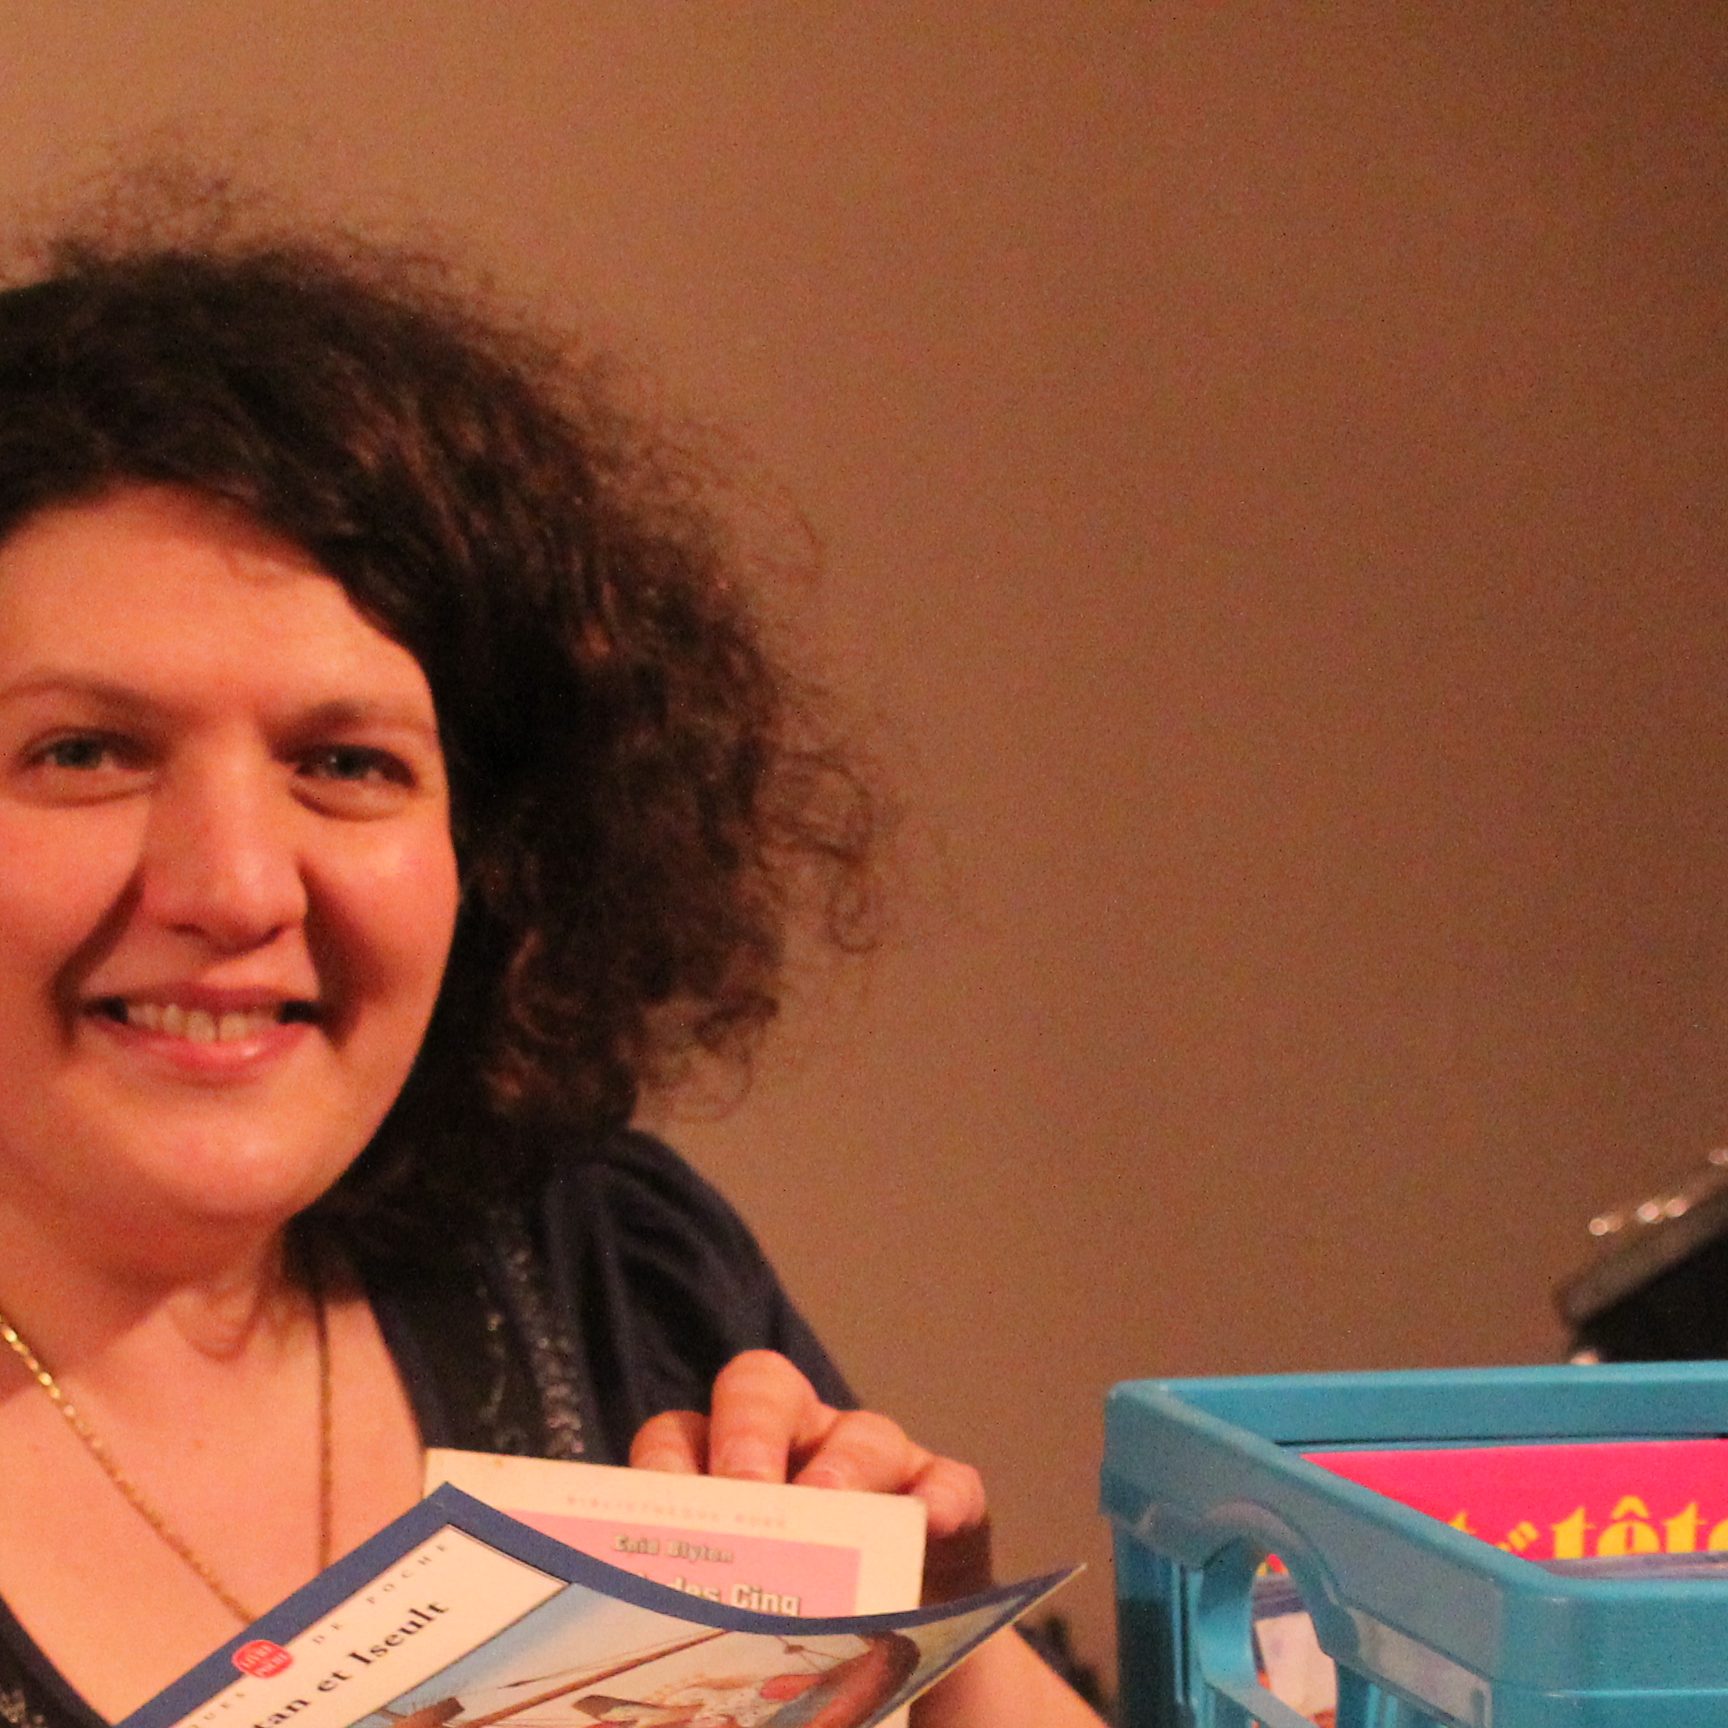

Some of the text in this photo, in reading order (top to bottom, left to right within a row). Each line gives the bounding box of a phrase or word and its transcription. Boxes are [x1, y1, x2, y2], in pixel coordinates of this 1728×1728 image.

[366, 1543, 449, 1606] POCHE
[615, 1534, 734, 1564] Enid Blyton
[315, 1665, 353, 1694] et
[347, 1599, 451, 1667] Iseult
